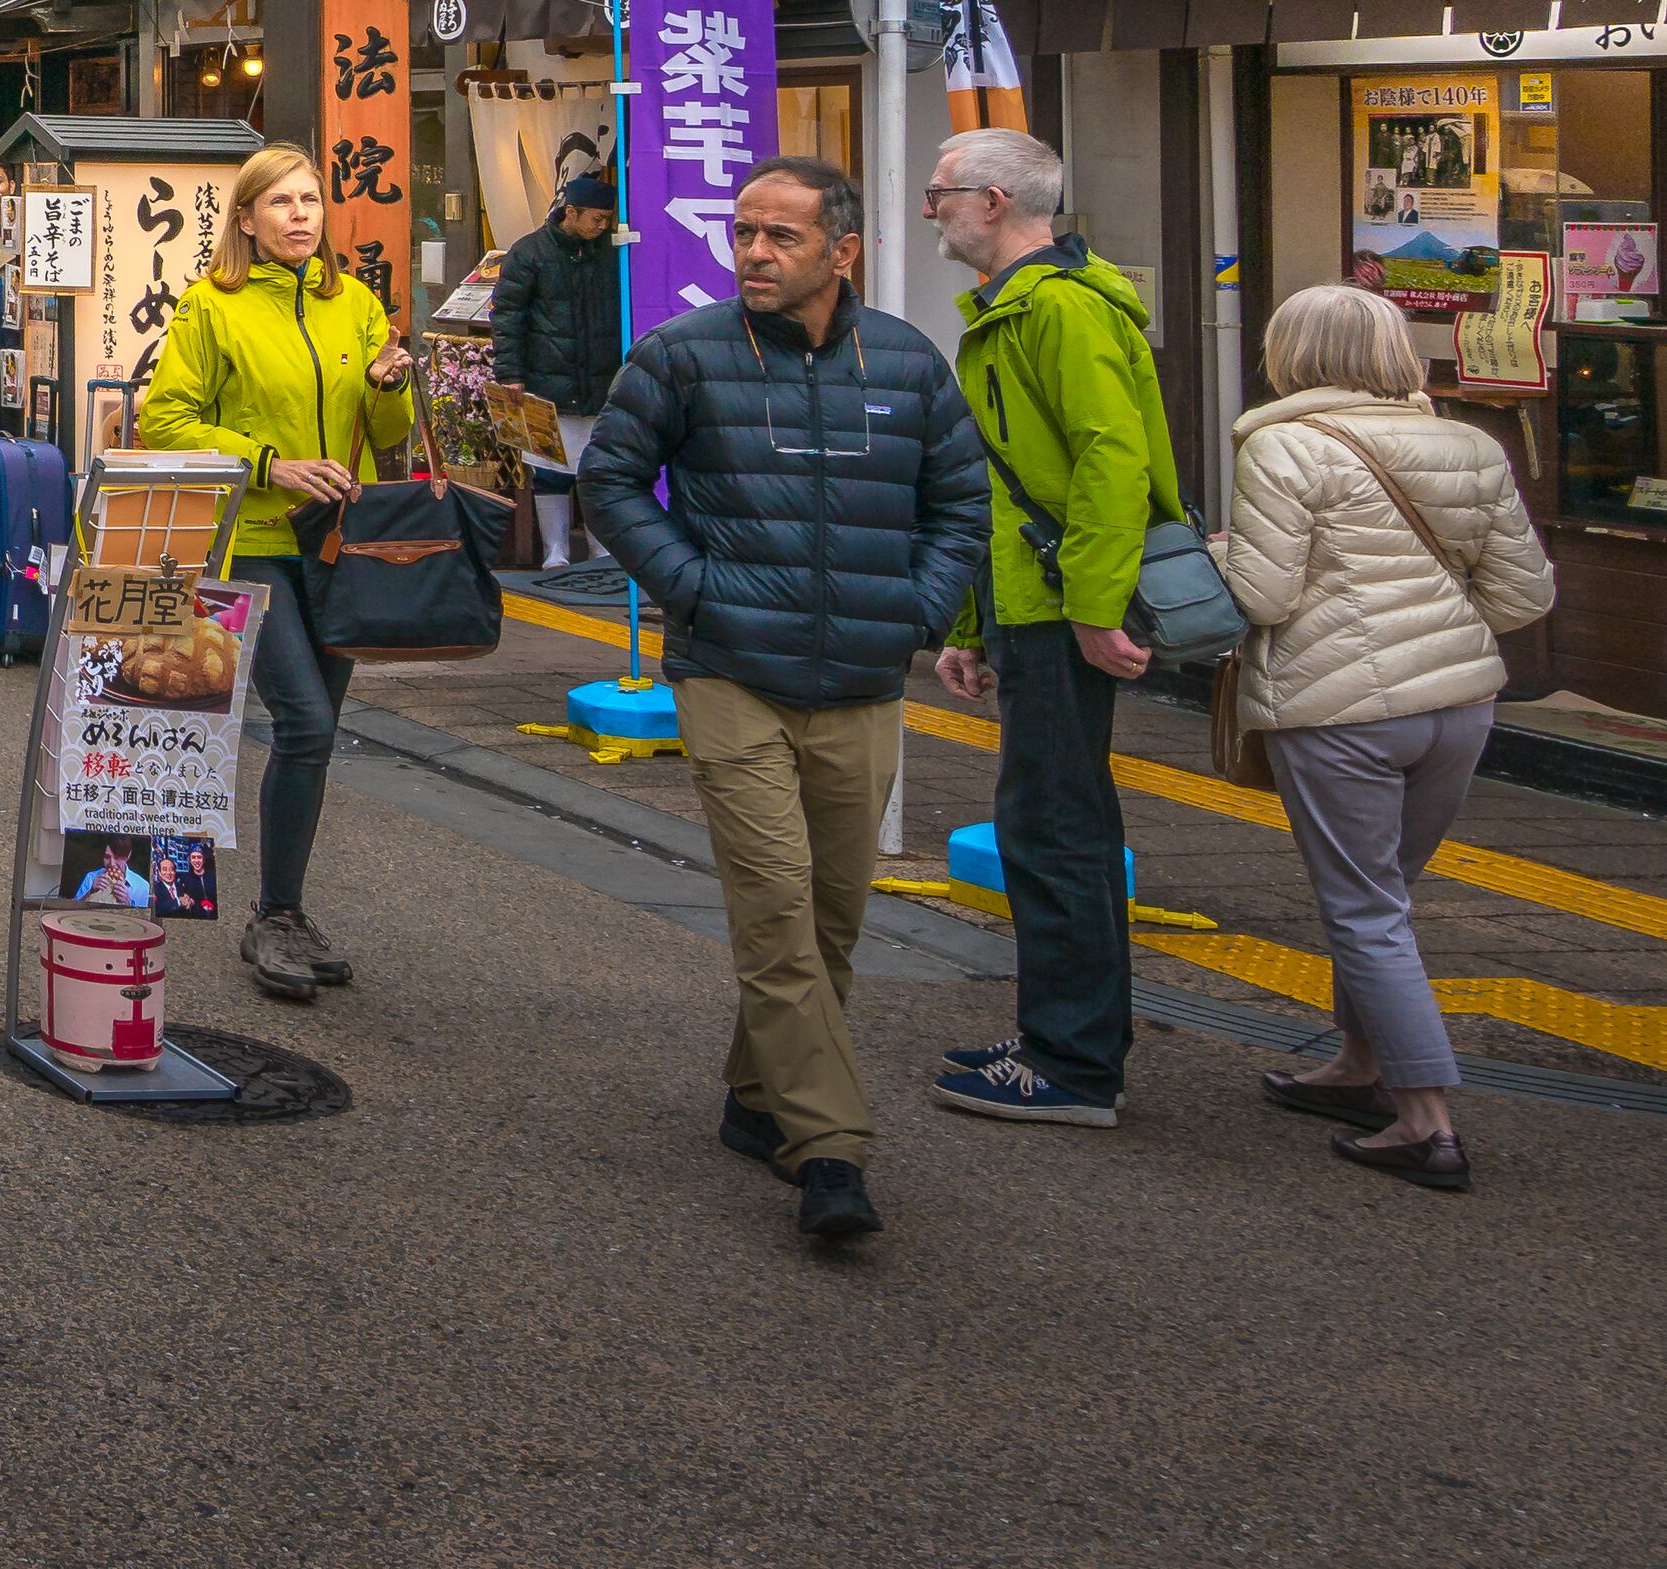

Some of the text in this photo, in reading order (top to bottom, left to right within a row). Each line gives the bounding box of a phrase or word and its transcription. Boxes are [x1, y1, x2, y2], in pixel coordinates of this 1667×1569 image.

[1362, 86, 1489, 107] お陰様で140年
[68, 198, 90, 247] ごまの
[42, 197, 63, 284] 旨辛そば
[78, 578, 189, 626] 花月堂
[81, 722, 207, 754] めろんぱん
[82, 751, 219, 780] 移転となりました
[65, 783, 229, 812] 迁移了 面包 请走这边
[85, 808, 202, 826] traditional sweet bread
[85, 821, 121, 833] moved
[123, 825, 147, 834] over
